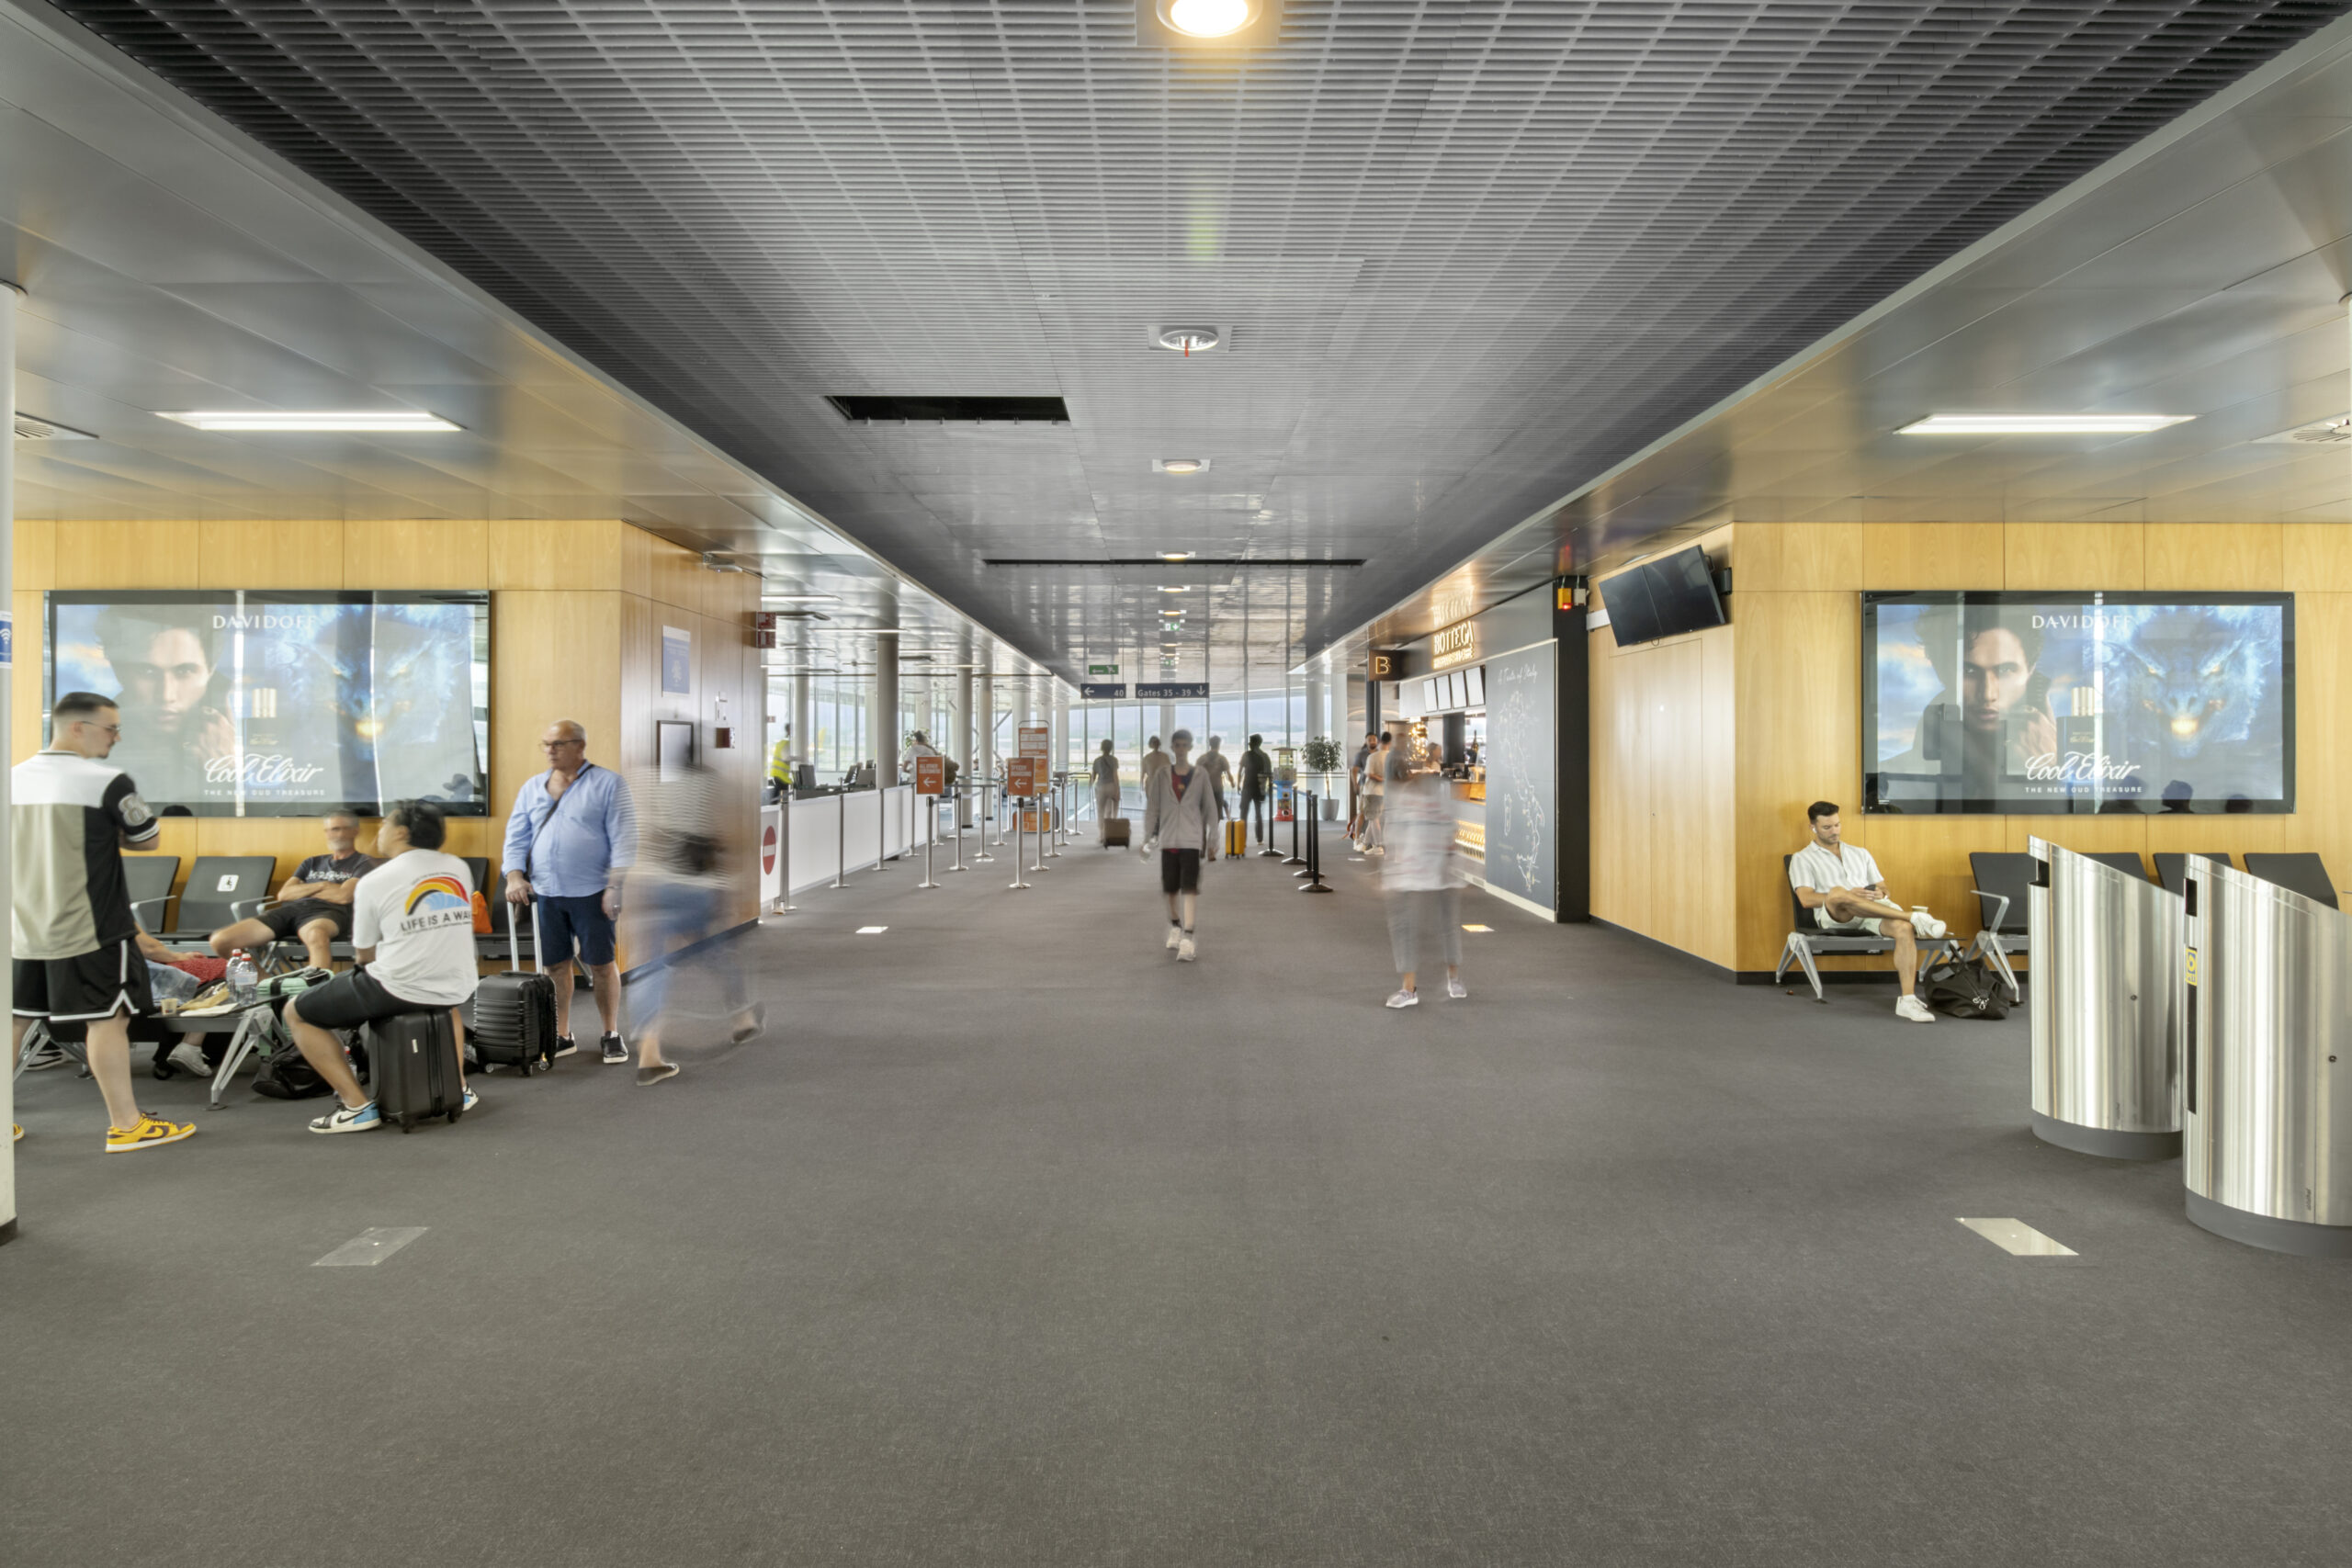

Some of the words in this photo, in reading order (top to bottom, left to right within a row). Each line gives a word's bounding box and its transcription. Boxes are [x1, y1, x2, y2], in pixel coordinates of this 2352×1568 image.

[212, 615, 317, 629] DAVIDOFF
[1434, 619, 1474, 655] BOTTEGA
[1374, 656, 1391, 675] B
[1114, 689, 1124, 697] 40
[1137, 689, 1160, 697] Gates
[1162, 689, 1173, 697] 35
[1182, 689, 1192, 697] 39
[204, 755, 260, 783] Cool
[246, 753, 324, 783] Elixir
[2024, 752, 2080, 781] Cool
[2066, 750, 2142, 781] Elixir
[401, 917, 425, 931] LIFE
[427, 915, 438, 926] IS
[443, 912, 451, 922] A
